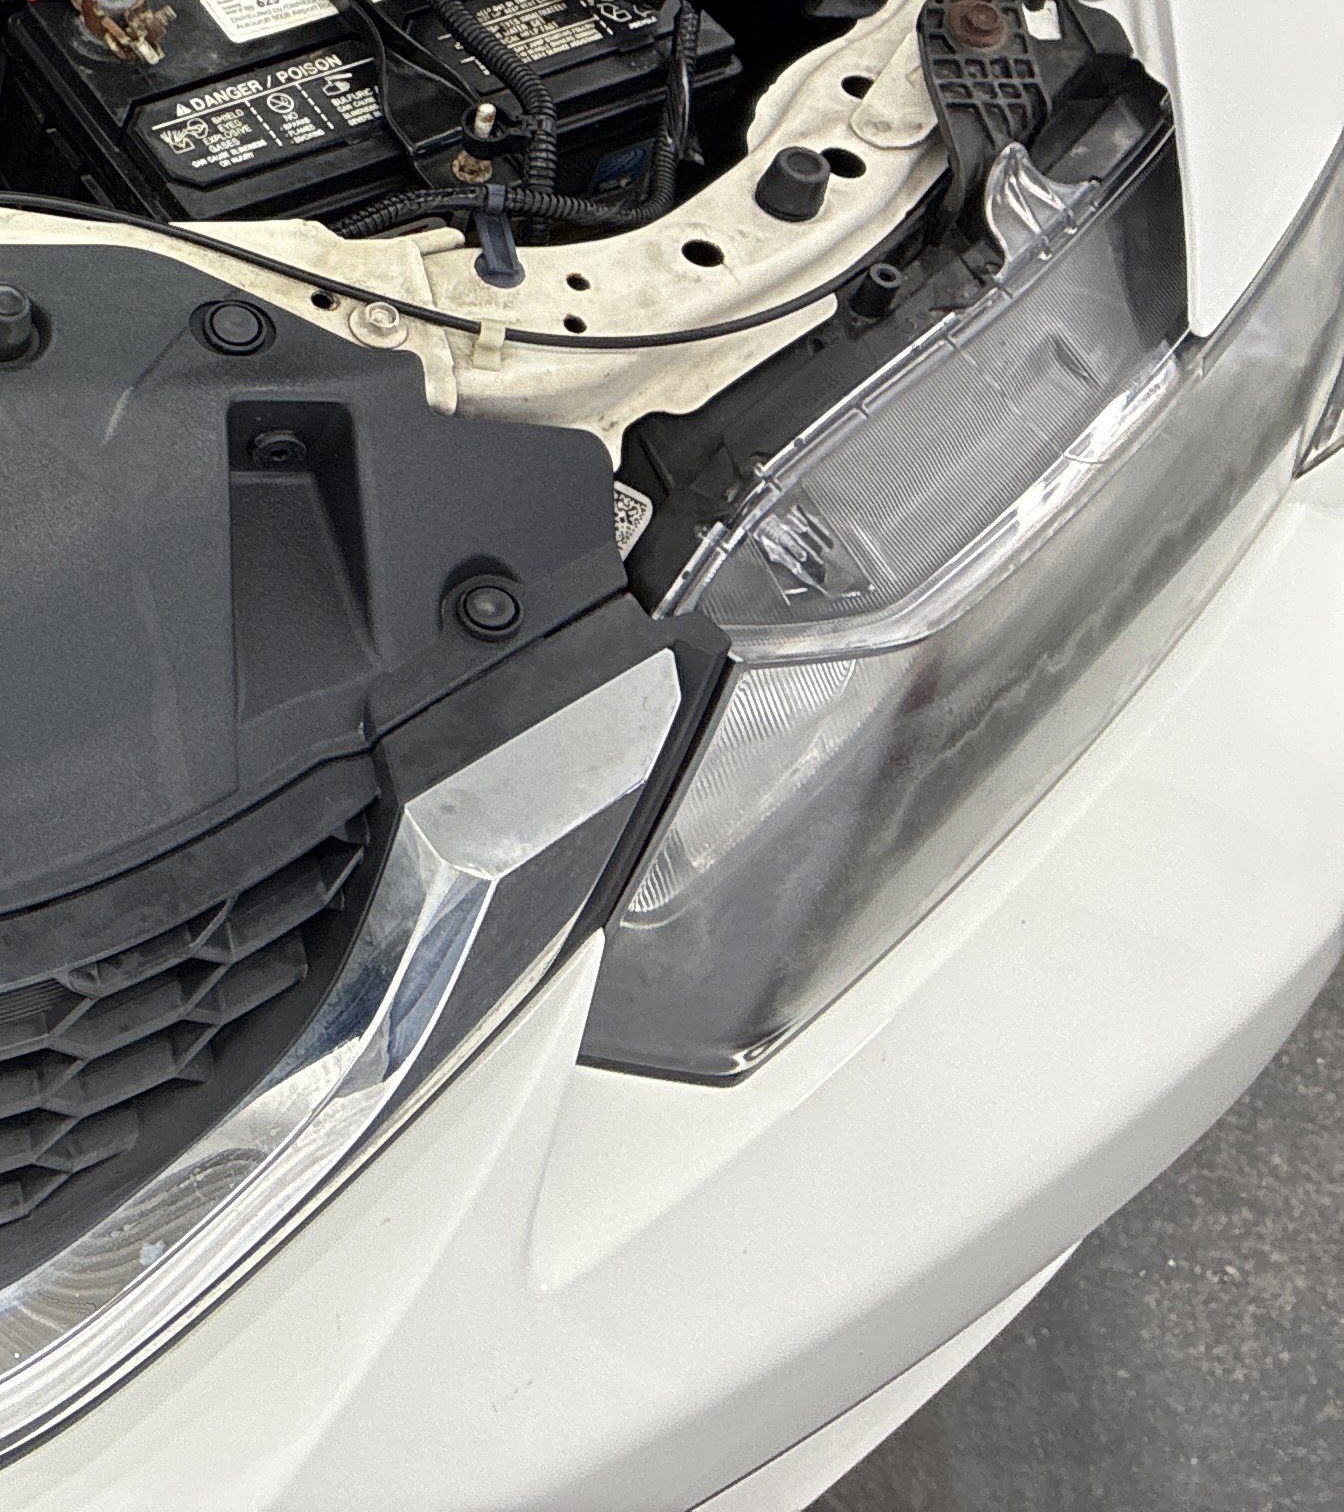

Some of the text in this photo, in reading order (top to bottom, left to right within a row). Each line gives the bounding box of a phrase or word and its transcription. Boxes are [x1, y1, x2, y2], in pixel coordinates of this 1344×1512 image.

[190, 80, 262, 111] DANGER
[276, 54, 343, 84] POISON
[283, 111, 298, 122] NO
